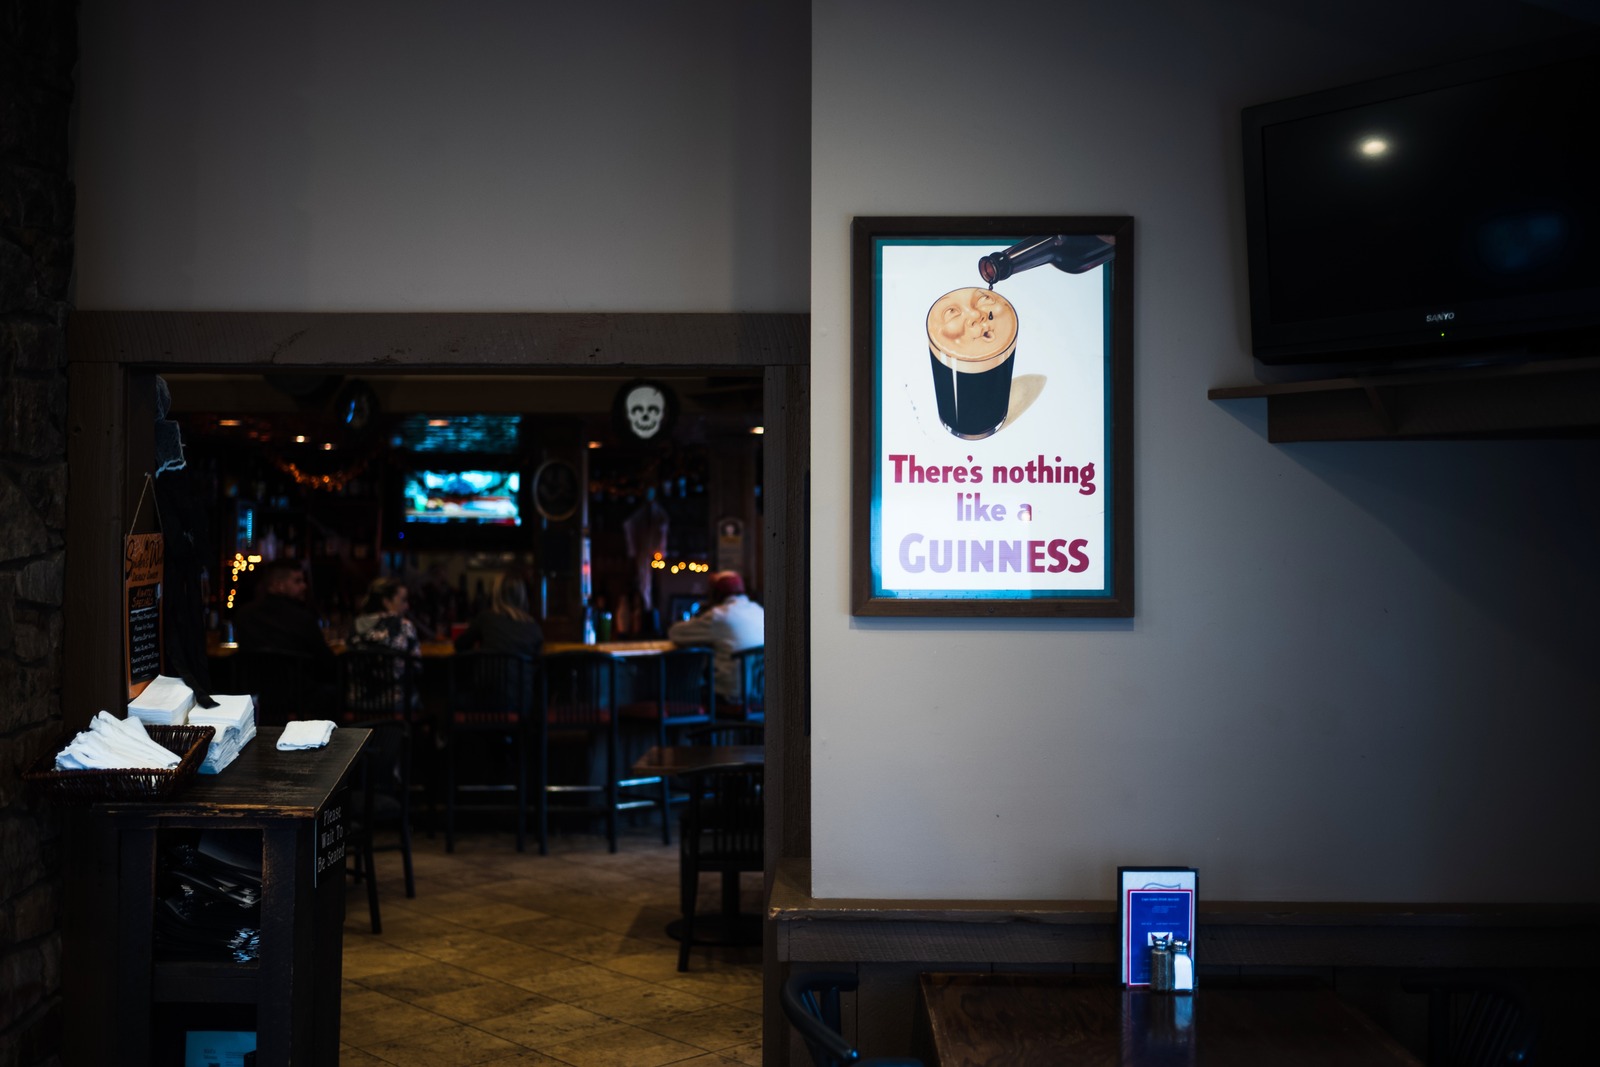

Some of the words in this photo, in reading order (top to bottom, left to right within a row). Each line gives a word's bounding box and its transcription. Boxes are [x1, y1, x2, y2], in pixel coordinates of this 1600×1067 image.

[1426, 311, 1455, 323] SANYO
[889, 454, 984, 484] There's
[992, 454, 1097, 496] nothing
[956, 492, 1007, 522] like
[1017, 503, 1033, 522] a
[898, 532, 1090, 574] GUINNESS
[323, 805, 342, 827] Please
[321, 828, 335, 849] Wait
[336, 824, 344, 841] To
[317, 856, 326, 873] Be
[327, 841, 346, 867] Seated
